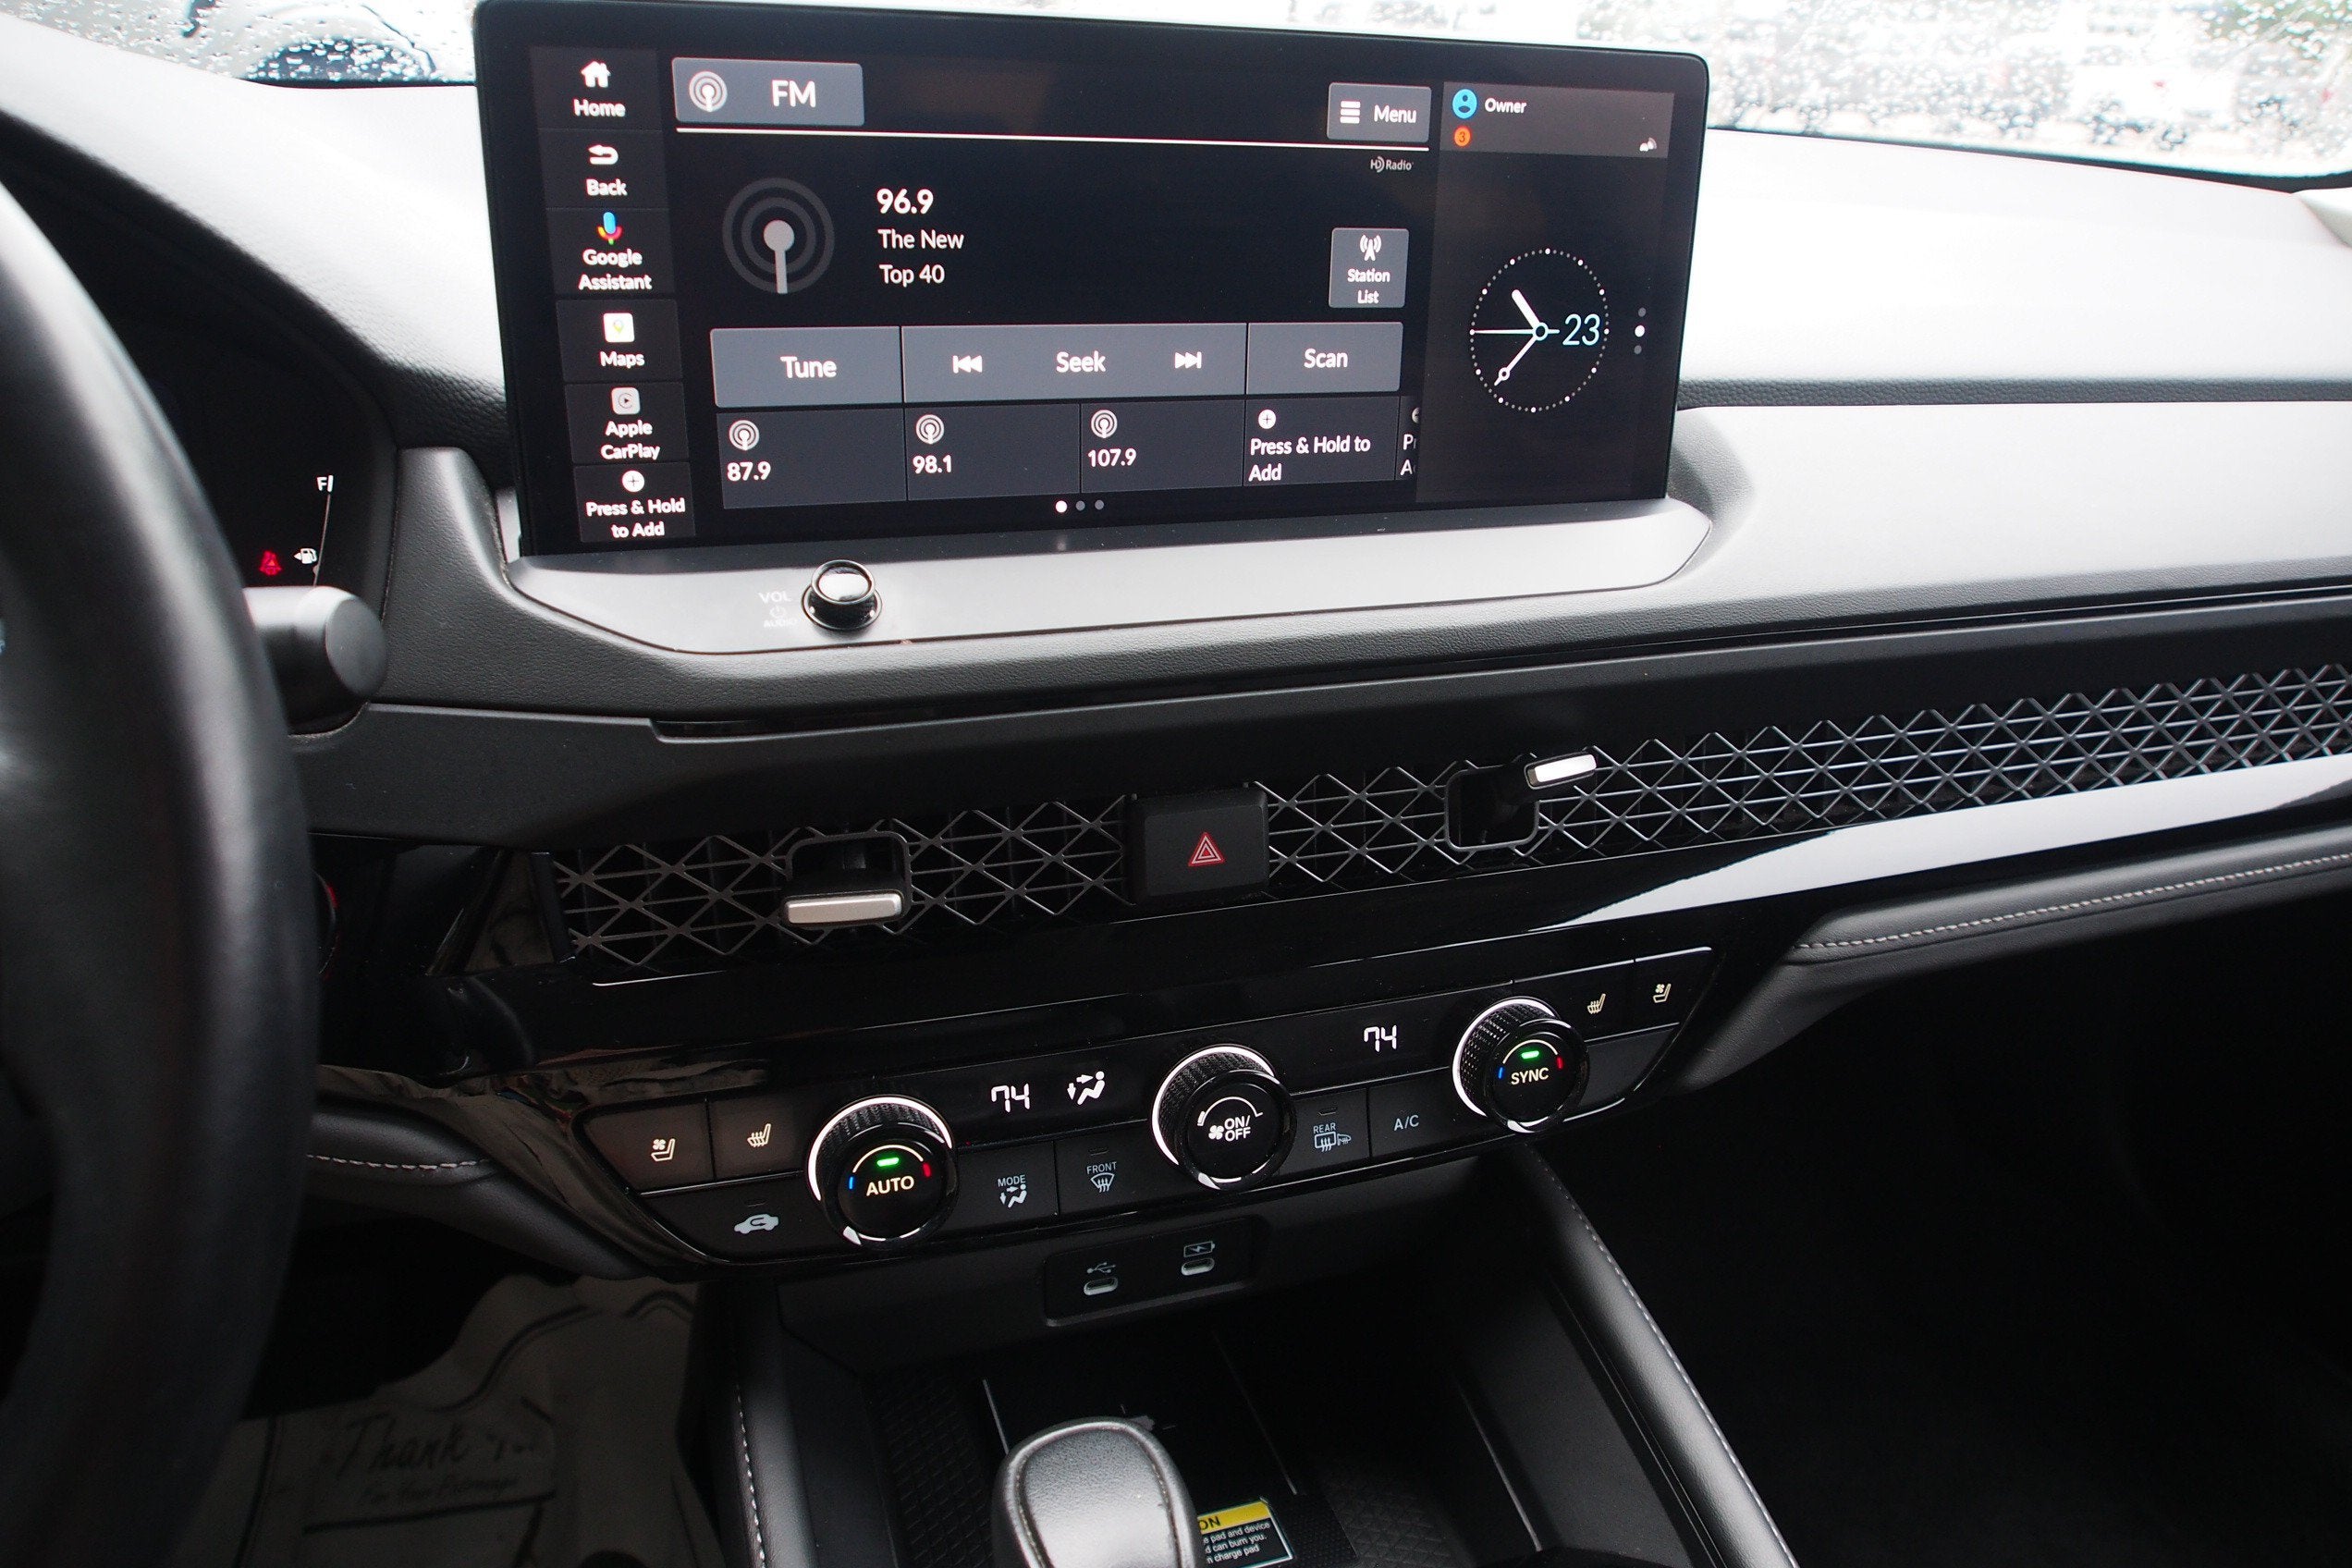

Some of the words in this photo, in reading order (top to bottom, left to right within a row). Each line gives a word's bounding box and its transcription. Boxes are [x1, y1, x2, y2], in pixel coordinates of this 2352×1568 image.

[771, 80, 816, 108] FM
[573, 98, 626, 117] Home
[1374, 104, 1417, 124] Menu
[1484, 97, 1527, 114] Owner
[1385, 158, 1413, 172] Radio
[585, 178, 628, 196] Back
[876, 188, 934, 214] 96.9
[877, 228, 915, 250] The
[920, 228, 965, 250] New
[582, 248, 643, 269] Google
[578, 273, 653, 290] Assistant
[878, 263, 914, 288] Top
[918, 263, 946, 284] 40
[1347, 267, 1390, 283] Station
[1357, 288, 1379, 304] List
[1562, 312, 1600, 346] 23
[599, 350, 645, 369] Maps
[779, 355, 838, 379] Tune
[1056, 349, 1107, 374] Seek
[1304, 348, 1349, 369] Scan
[605, 419, 654, 438] Apple
[600, 442, 661, 460] CarPlay
[1250, 437, 1292, 456] Press
[1295, 436, 1310, 455] &
[1313, 435, 1351, 454] Hold
[1354, 435, 1371, 452] to
[913, 454, 952, 474] 98.1
[1087, 447, 1137, 468] 107.9
[727, 460, 772, 482] 87.9
[1248, 462, 1282, 483] Add
[585, 501, 629, 517] Press
[630, 499, 645, 515] &
[647, 496, 686, 514] Hold
[610, 524, 630, 539] to
[631, 521, 666, 538] Add
[758, 591, 792, 603] VOL
[1363, 1024, 1397, 1053] 74
[1511, 1067, 1550, 1085] SYNC
[990, 1083, 1031, 1113] 74
[1224, 1115, 1251, 1130] ON/
[1313, 1121, 1336, 1134] REAR
[1393, 1114, 1419, 1132] A/C
[1225, 1127, 1251, 1142] OFF
[1086, 1161, 1117, 1174] FRONT
[865, 1175, 915, 1196] AUTO
[998, 1174, 1026, 1187] MODE
[1243, 1521, 1270, 1534] device
